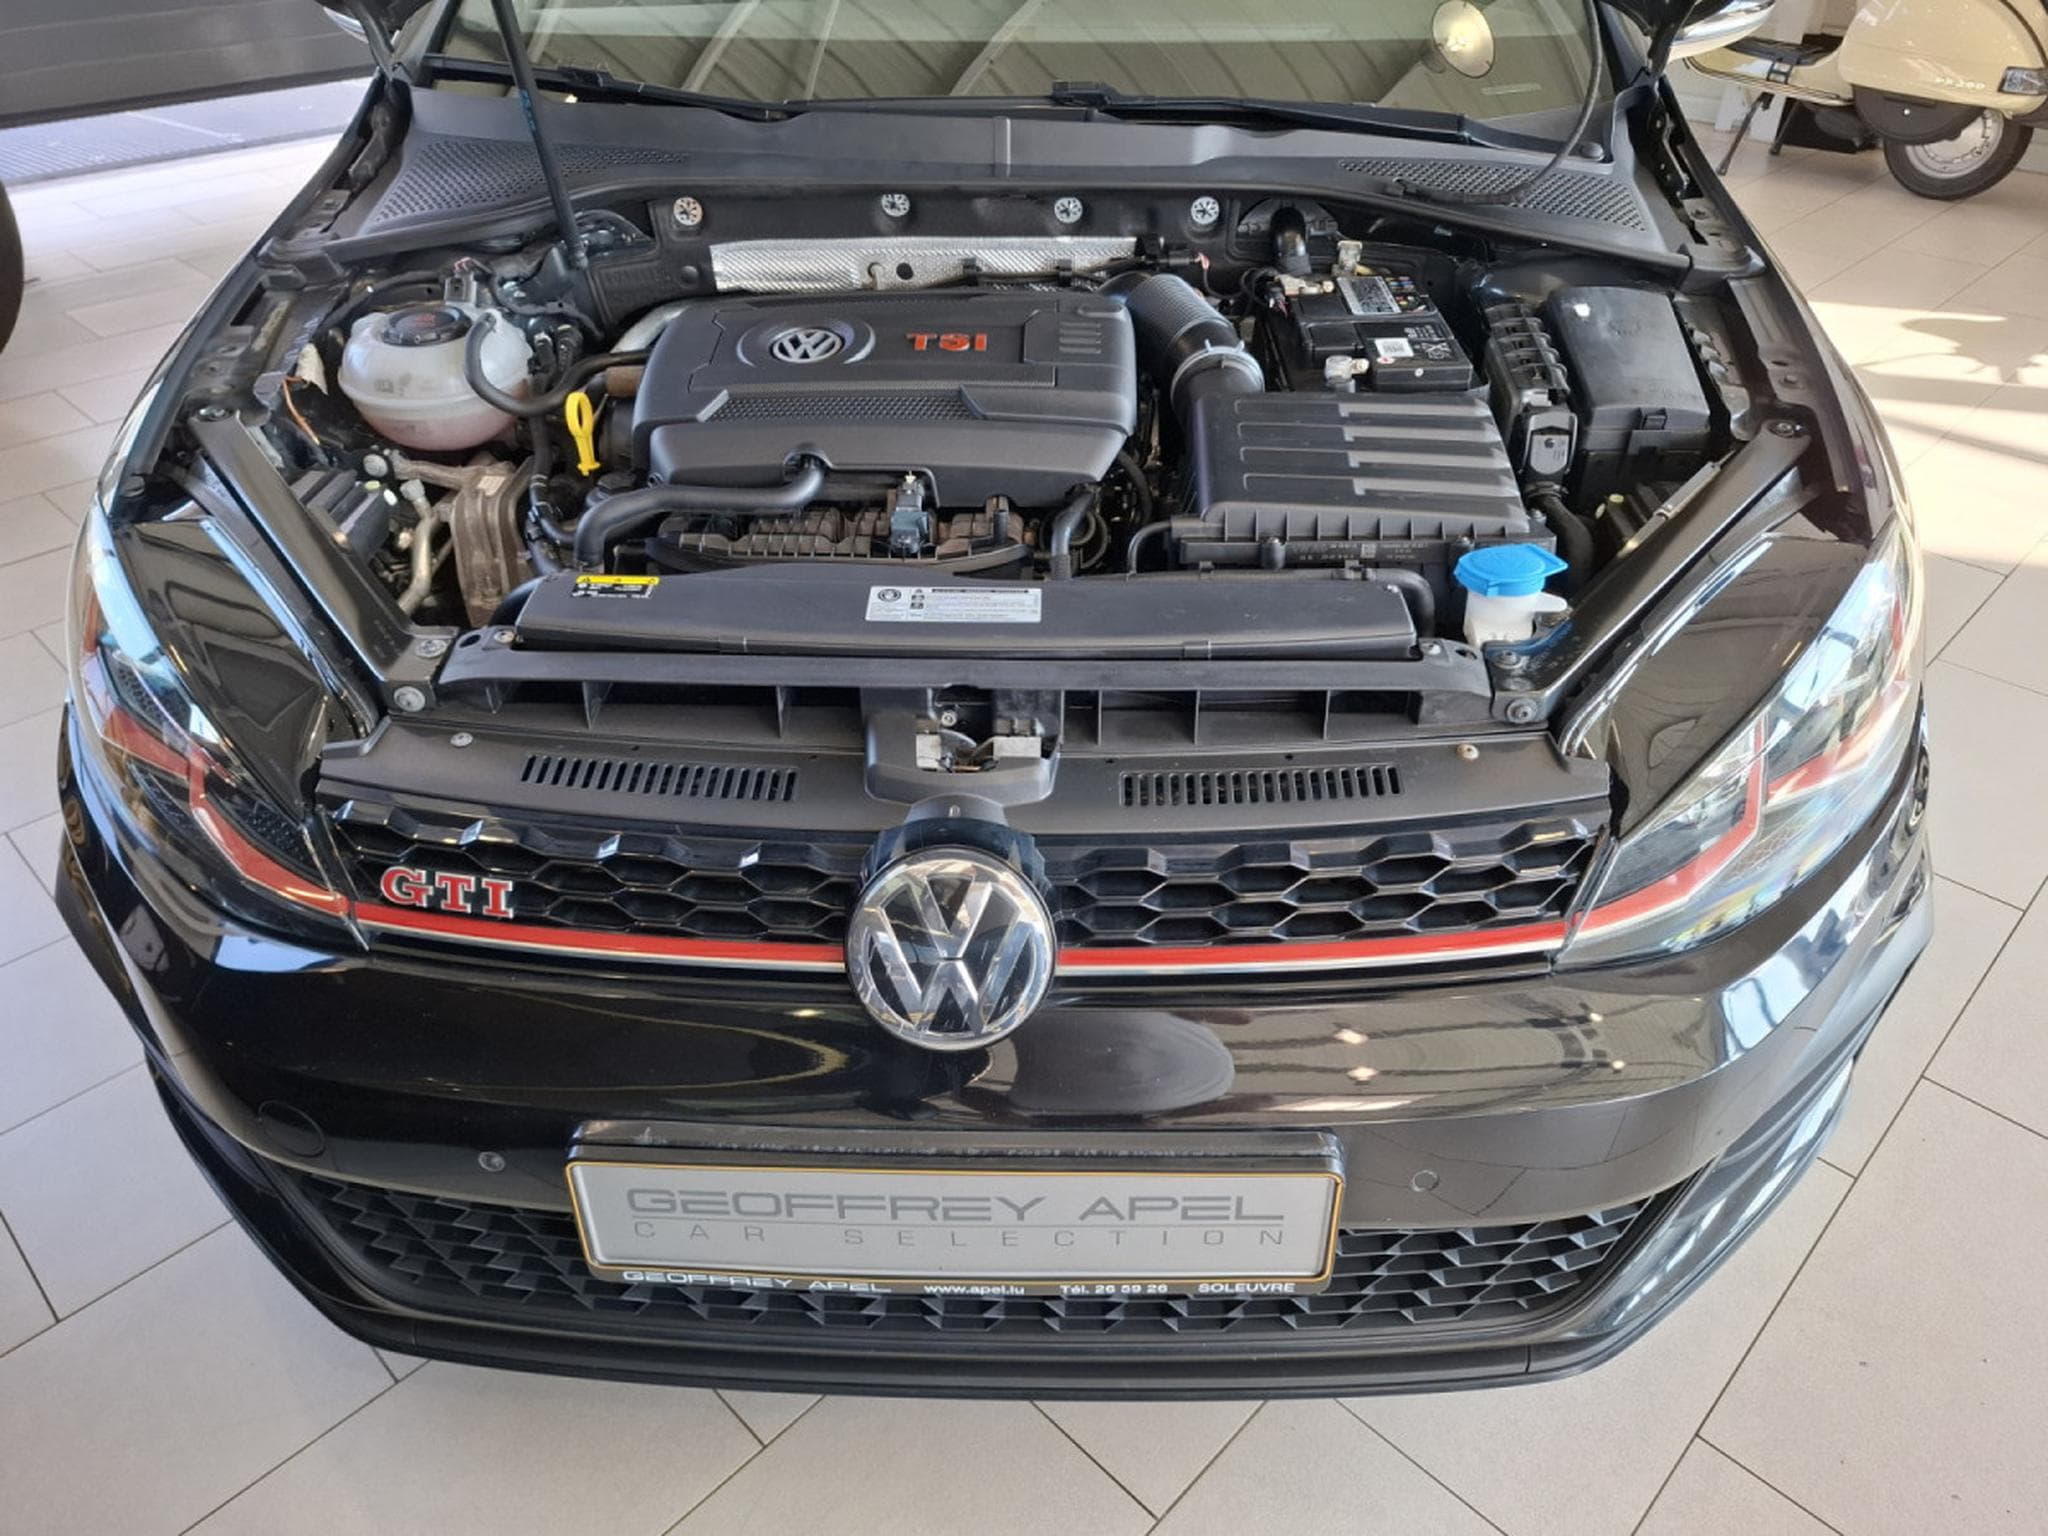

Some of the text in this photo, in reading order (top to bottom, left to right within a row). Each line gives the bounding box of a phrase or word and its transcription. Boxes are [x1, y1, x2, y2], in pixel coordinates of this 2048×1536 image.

[906, 332, 988, 352] TSI
[380, 866, 514, 919] GTI
[627, 1188, 1285, 1222] GEOFFREY APEL
[633, 1221, 1284, 1248] CAR SELECTION
[622, 1270, 794, 1289] GEOFFREY
[808, 1280, 893, 1293] APEL
[923, 1283, 1026, 1296] www.apel.lu
[1095, 1283, 1117, 1295] 26
[1146, 1283, 1169, 1294] 26
[1198, 1282, 1296, 1294] SOLEUVRE
